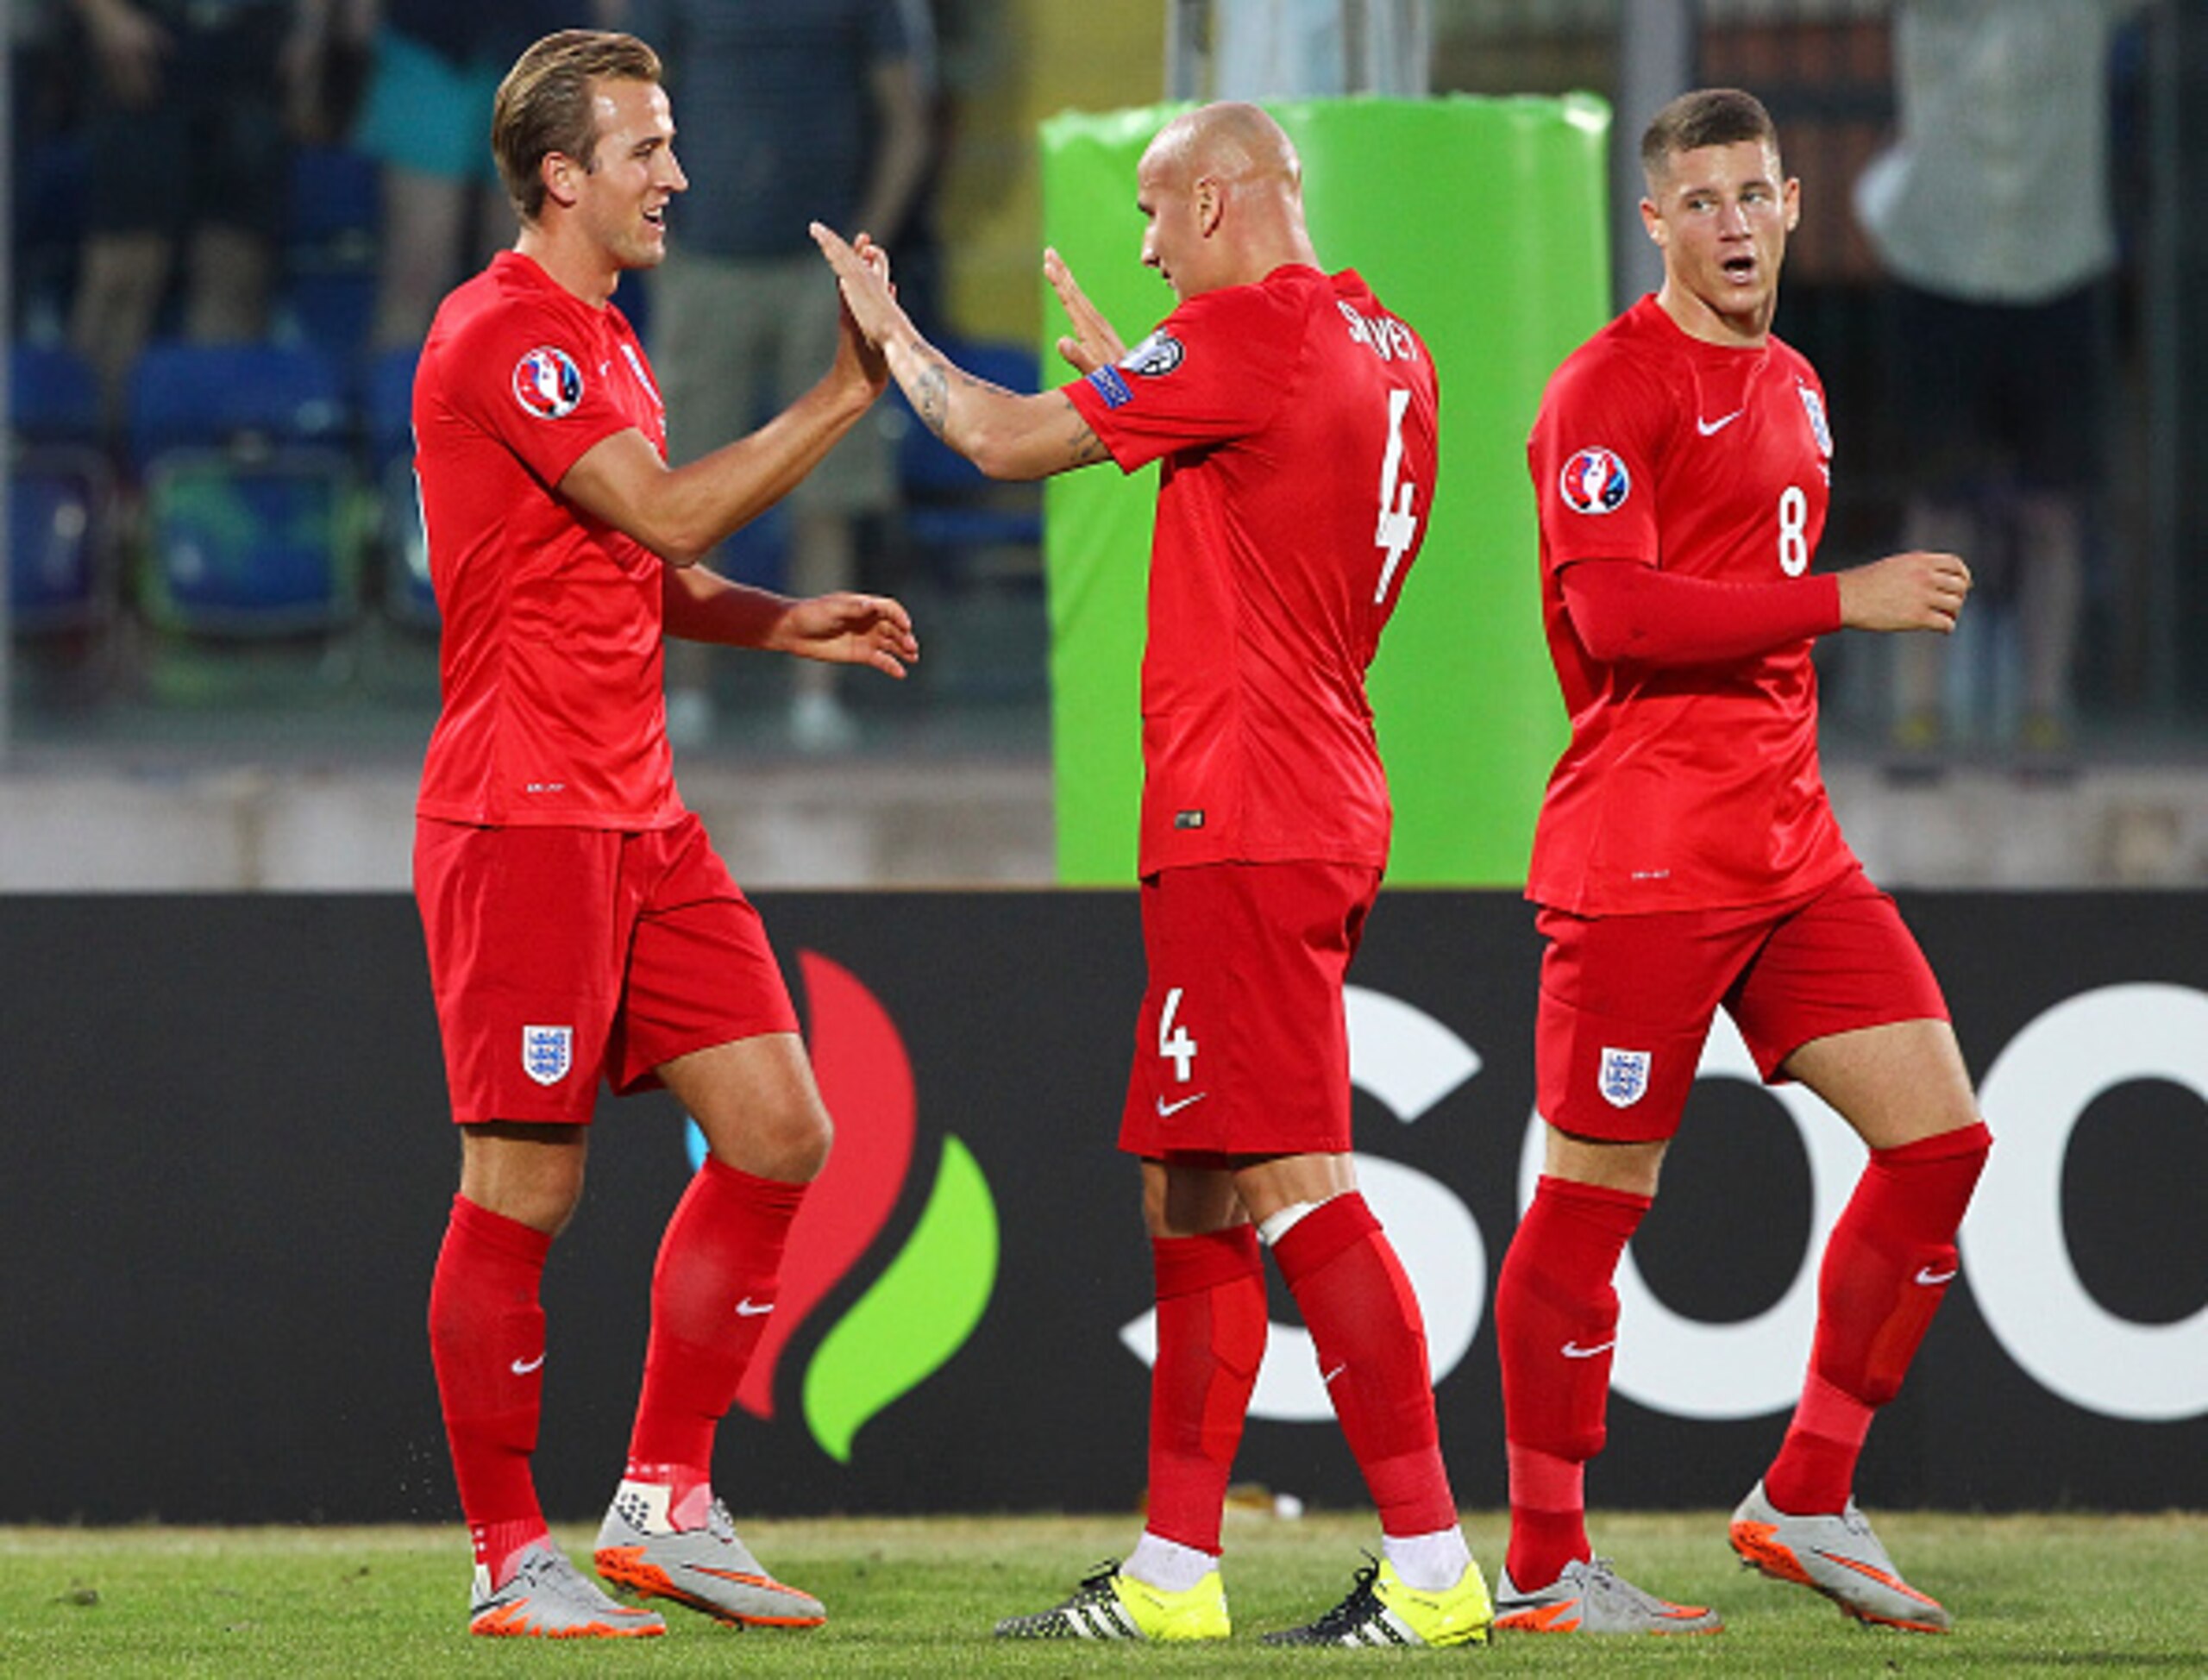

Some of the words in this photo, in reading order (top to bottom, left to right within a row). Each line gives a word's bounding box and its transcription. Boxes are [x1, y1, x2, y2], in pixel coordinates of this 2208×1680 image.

[1375, 389, 1417, 605] 4
[1778, 486, 1808, 577] 8
[1159, 987, 1198, 1083] 4
